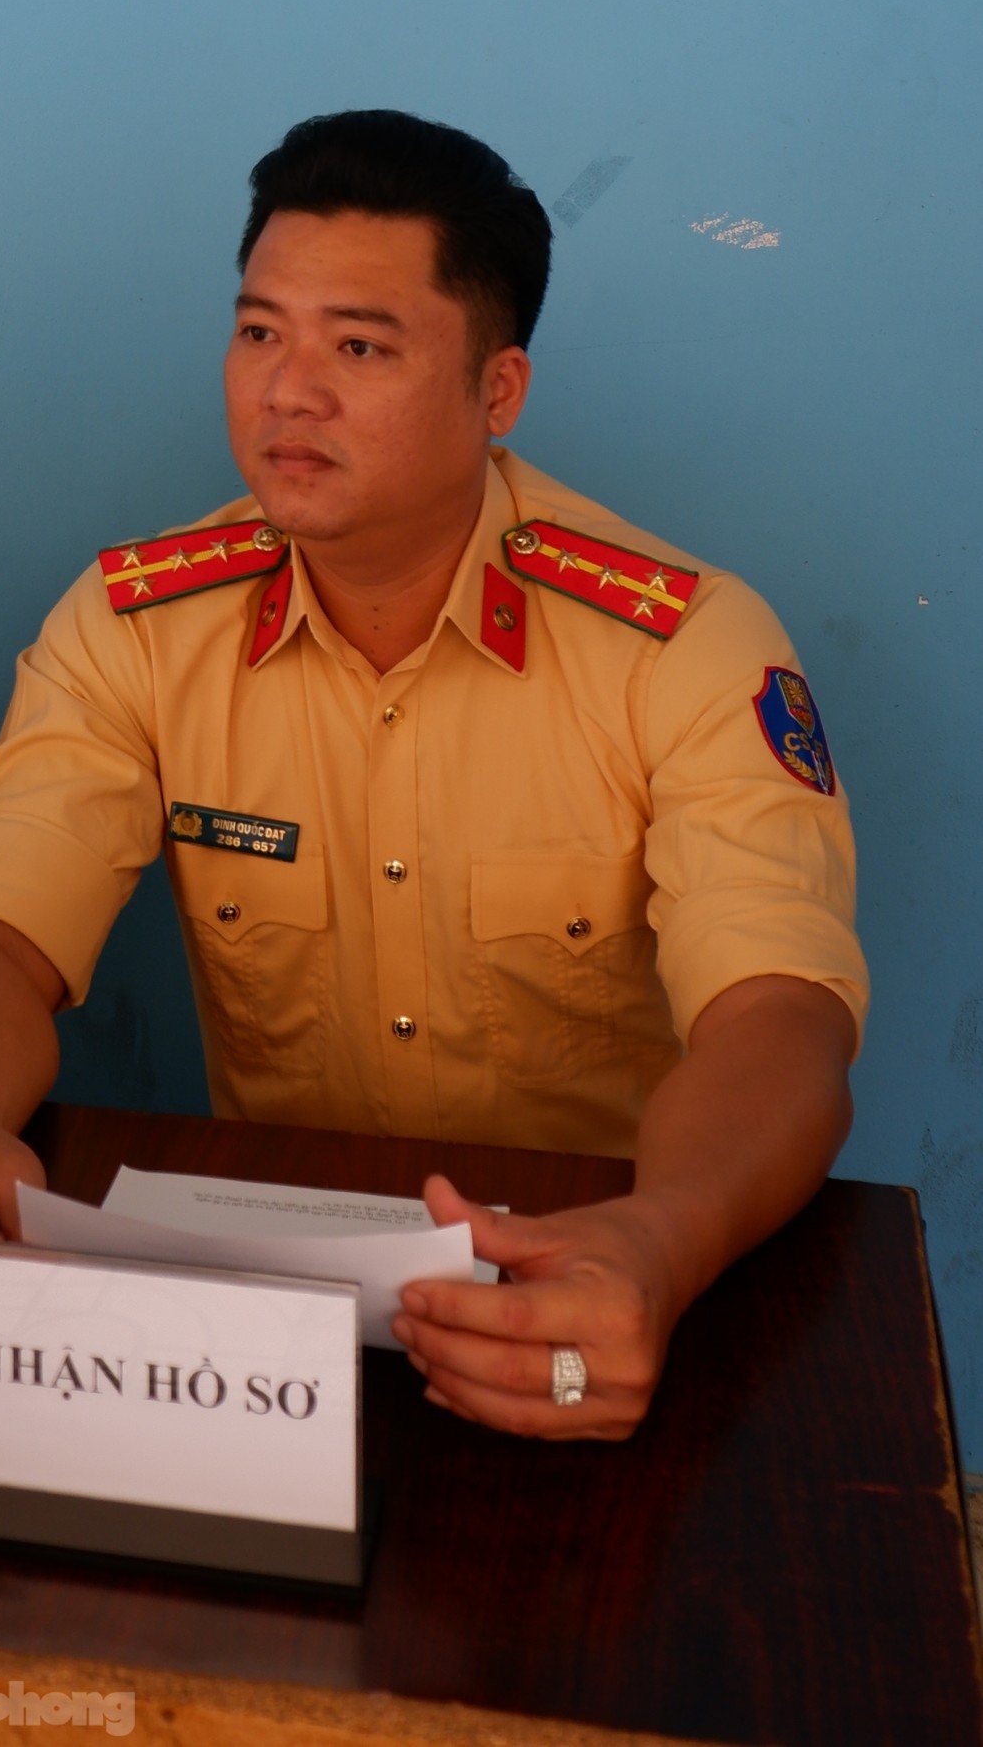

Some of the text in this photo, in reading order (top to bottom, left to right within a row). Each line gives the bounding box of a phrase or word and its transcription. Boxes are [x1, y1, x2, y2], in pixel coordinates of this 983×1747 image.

[217, 834, 241, 847] 286
[252, 840, 277, 853] 657
[143, 1356, 228, 1410] HỒ
[245, 1376, 320, 1421] SƠ
